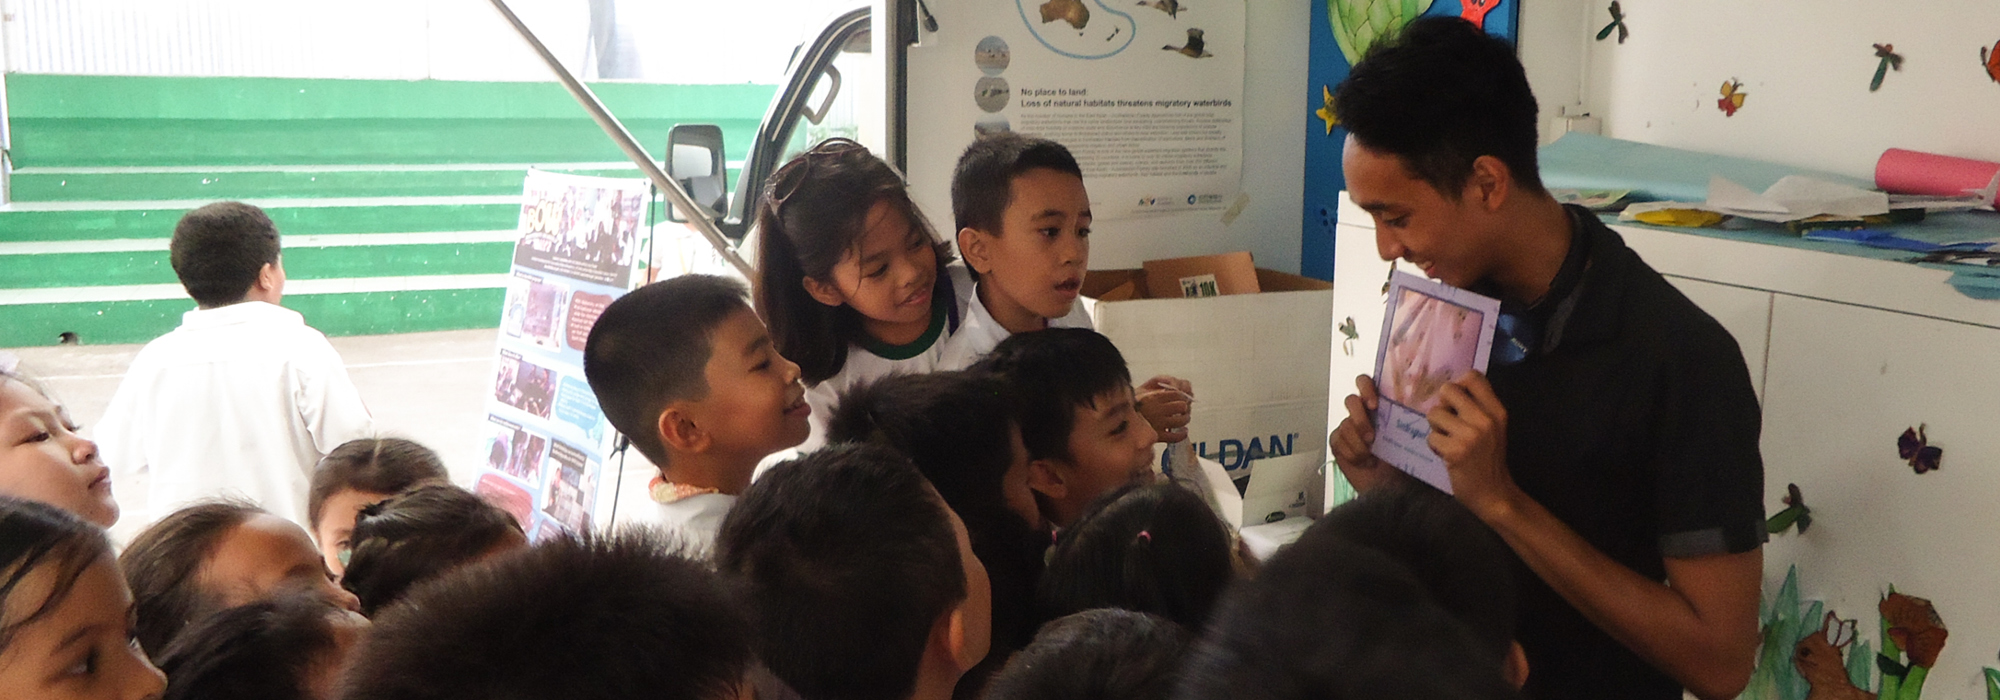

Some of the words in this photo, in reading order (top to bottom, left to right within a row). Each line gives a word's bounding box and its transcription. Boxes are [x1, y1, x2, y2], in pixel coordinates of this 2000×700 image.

[1021, 87, 1033, 96] No
[1035, 87, 1057, 98] place
[1058, 87, 1068, 96] to
[1021, 99, 1041, 108] Loss
[1043, 99, 1053, 108] of
[1054, 99, 1082, 108] natural
[1084, 99, 1116, 108] habitats
[1117, 99, 1153, 108] threatens
[1155, 99, 1191, 109] migratory
[1193, 99, 1232, 107] waterbirds
[1200, 280, 1217, 297] 10K
